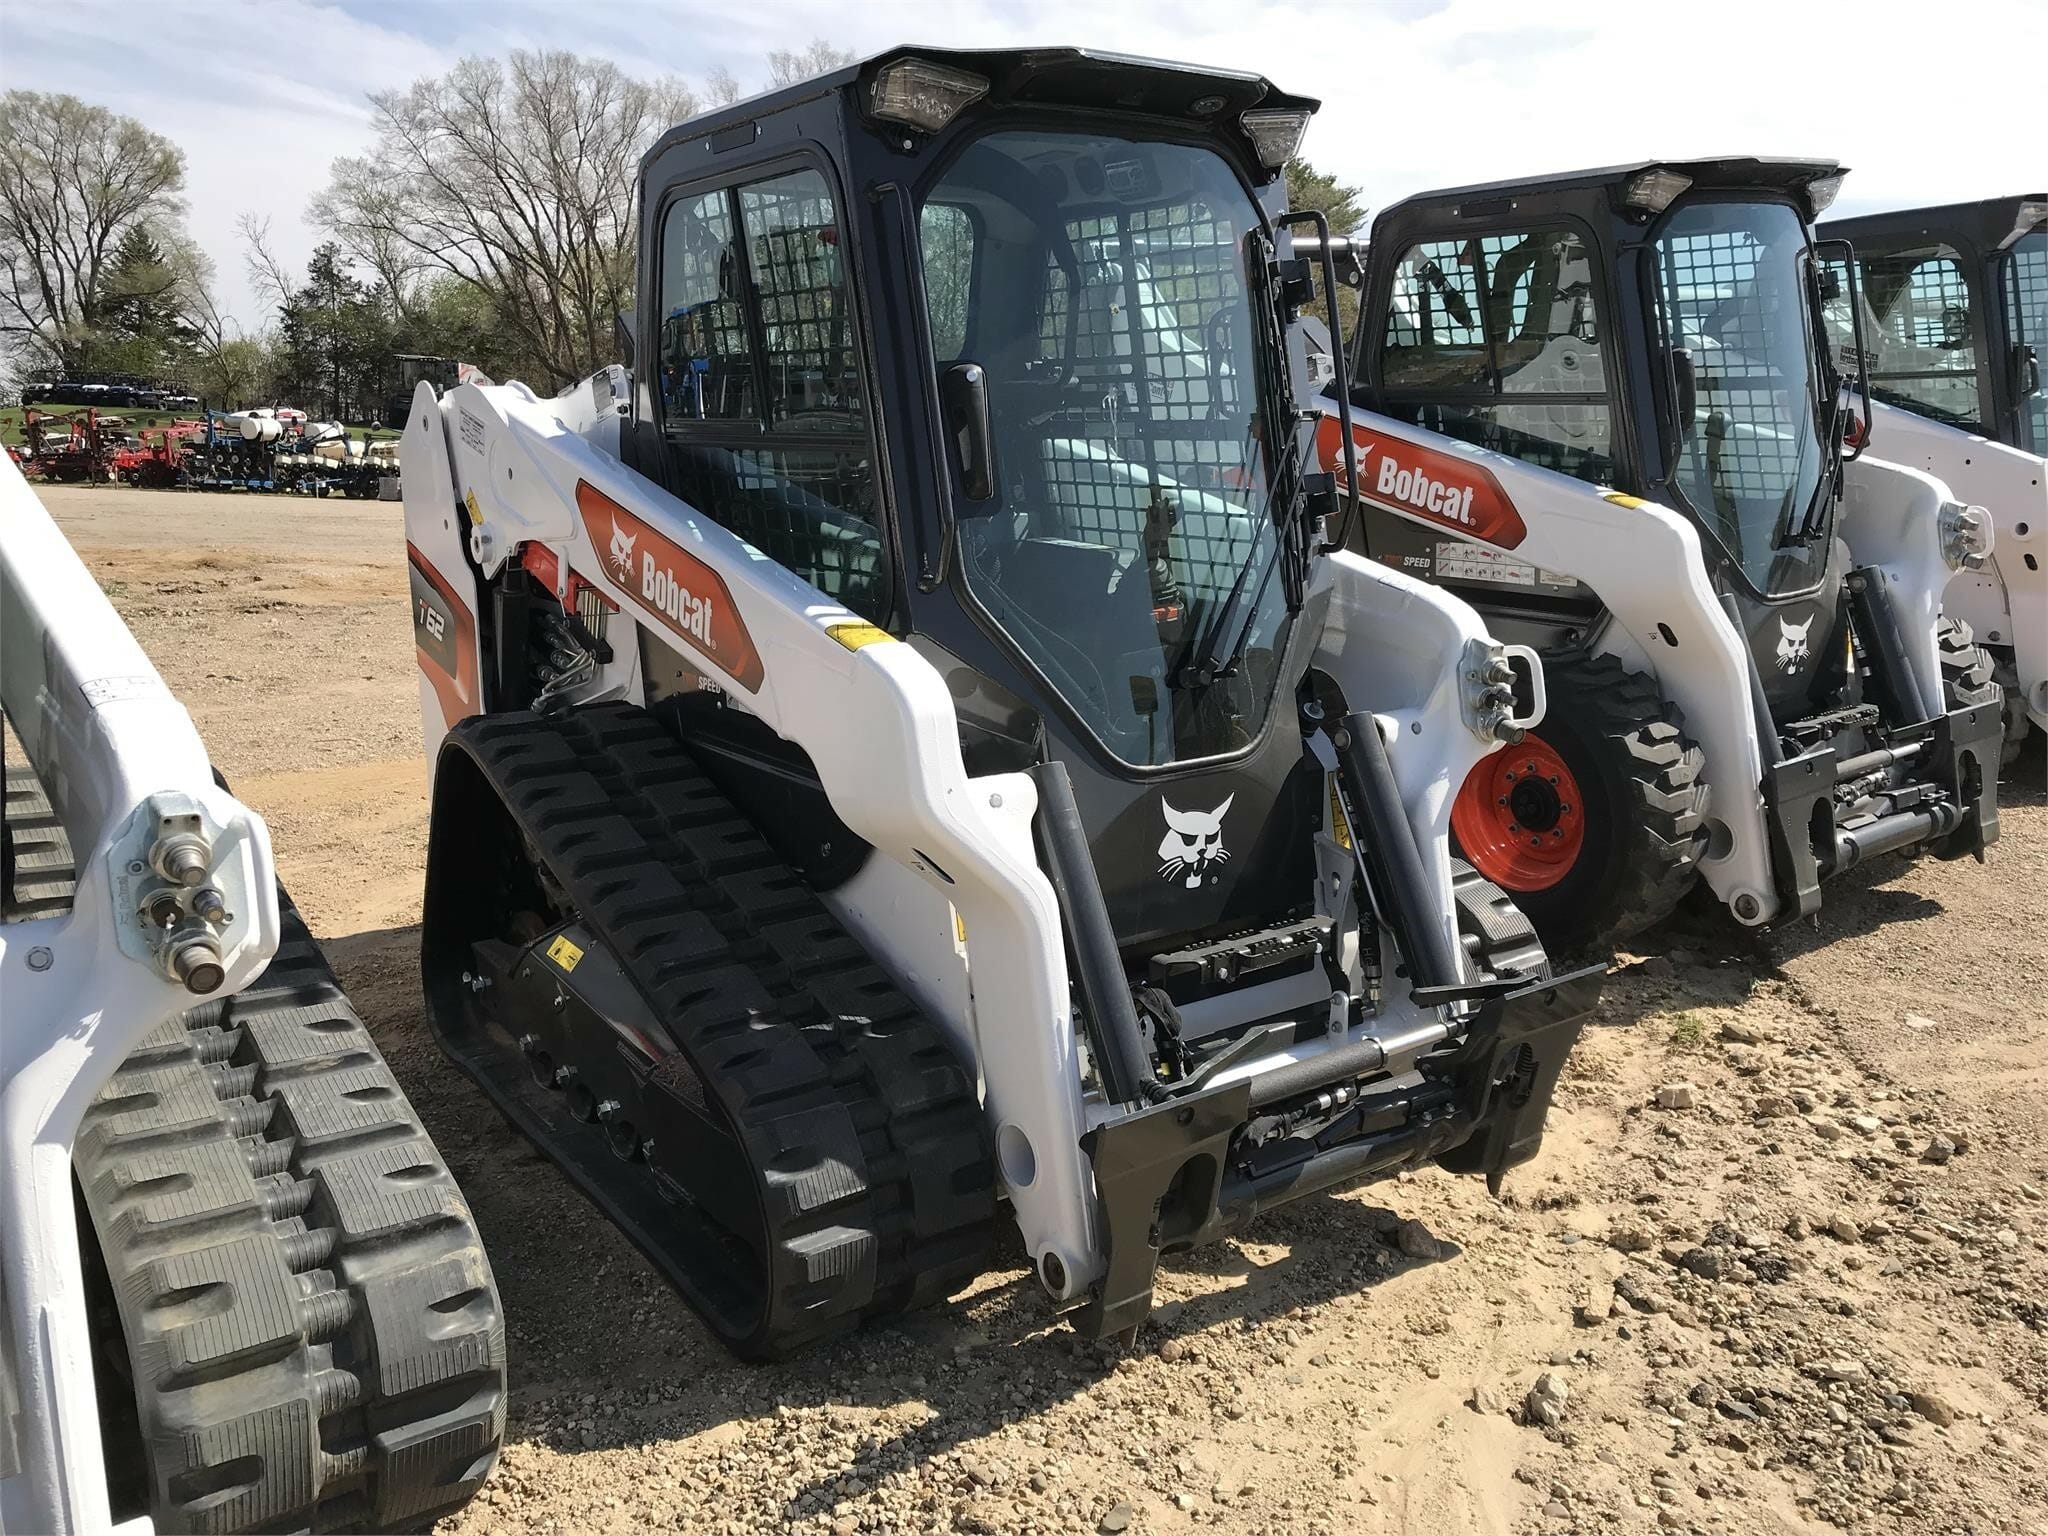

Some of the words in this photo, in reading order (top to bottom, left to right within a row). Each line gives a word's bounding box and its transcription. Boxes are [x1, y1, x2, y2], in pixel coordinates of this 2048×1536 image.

[1377, 455, 1474, 524] Bobcat
[1403, 556, 1431, 568] SPEED
[419, 598, 445, 642] T62
[642, 550, 713, 646] Bobcat
[698, 676, 721, 694] SPEED
